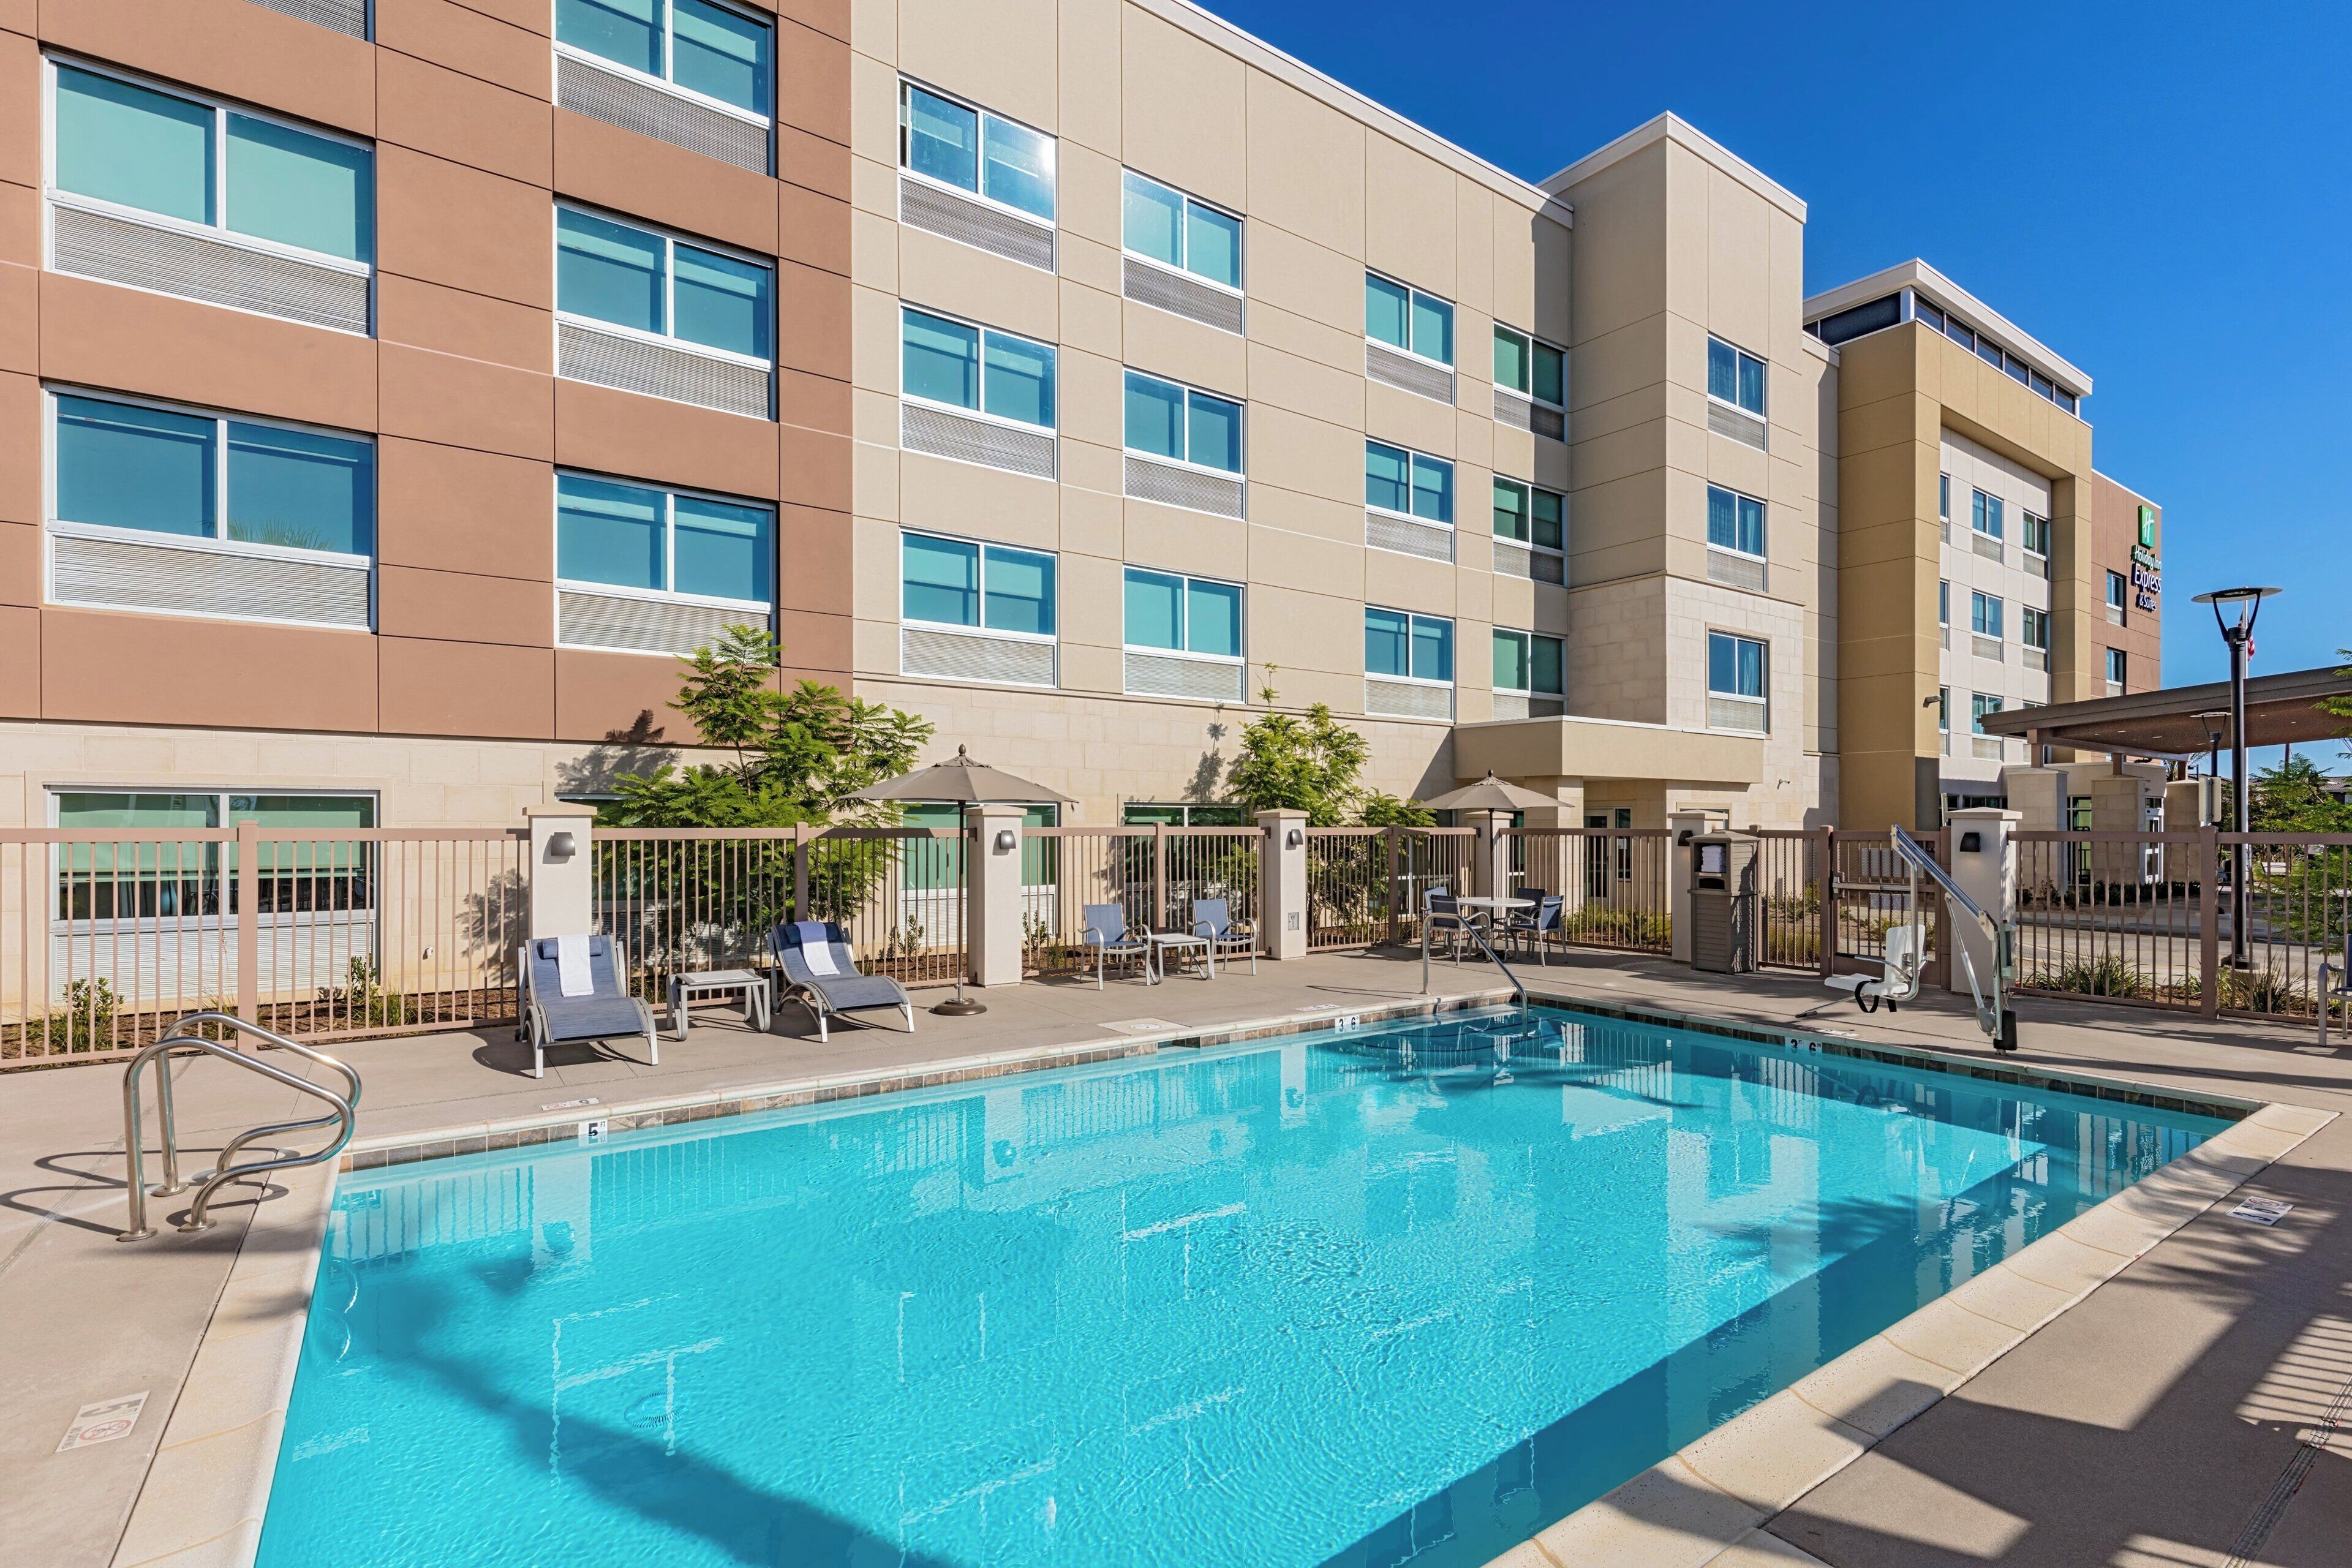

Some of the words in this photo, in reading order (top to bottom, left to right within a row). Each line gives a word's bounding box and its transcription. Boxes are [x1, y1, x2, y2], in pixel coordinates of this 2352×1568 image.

[2135, 545, 2154, 570] Holiday
[2135, 562, 2162, 594] Express
[2139, 593, 2144, 607] &
[2144, 594, 2157, 611] Suites
[1339, 1018, 1344, 1027] 3
[1351, 1017, 1356, 1025] 6
[1790, 1039, 1798, 1049] 3
[1809, 1042, 1817, 1051] 6
[588, 1122, 598, 1137] 5
[80, 1398, 143, 1418] 5
